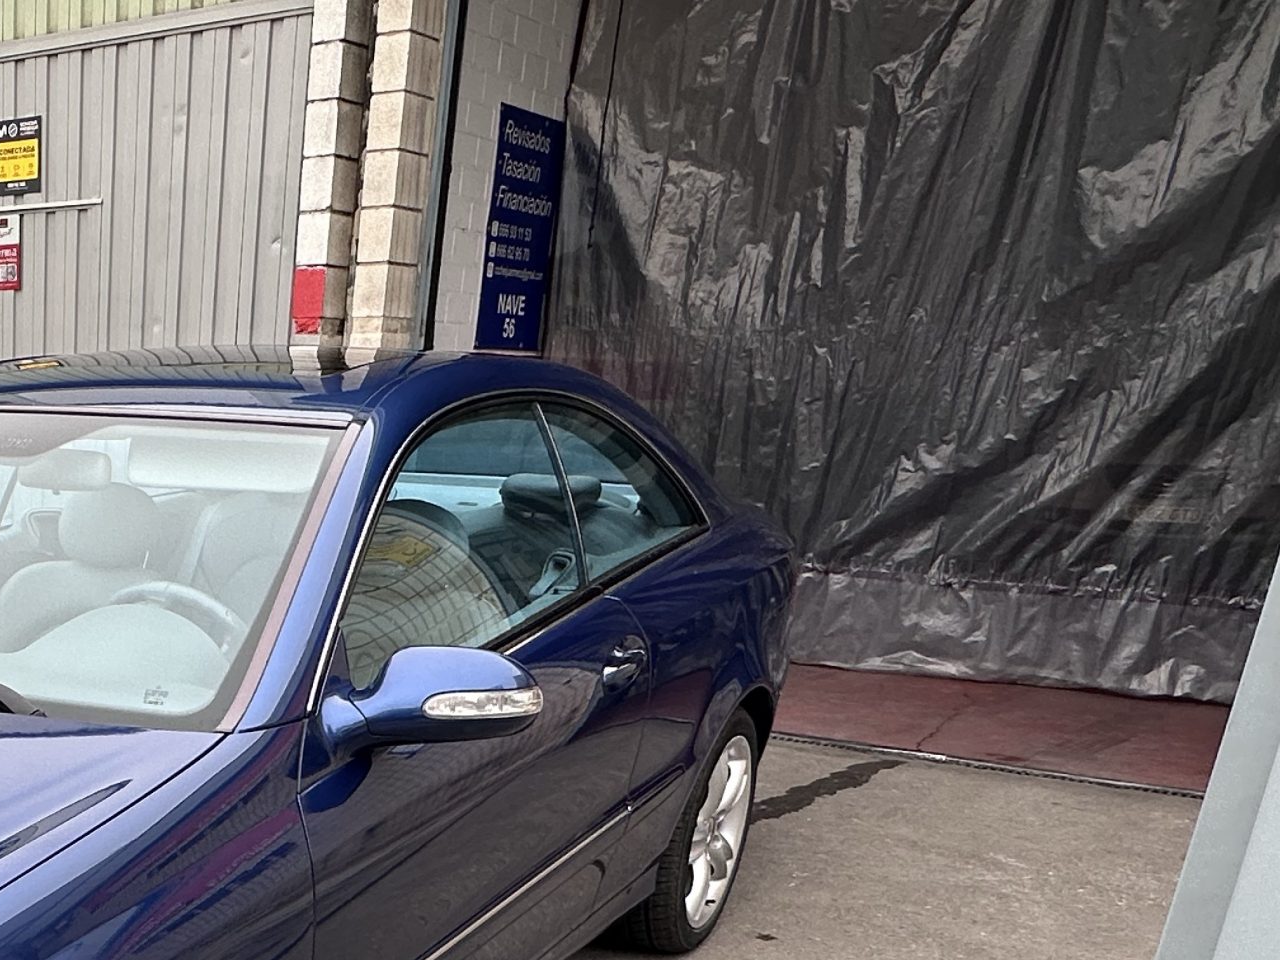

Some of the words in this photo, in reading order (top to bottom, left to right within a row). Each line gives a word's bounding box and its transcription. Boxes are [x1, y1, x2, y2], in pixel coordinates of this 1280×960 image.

[504, 120, 551, 154] Revisados
[502, 152, 541, 183] Tasación
[496, 185, 552, 217] Financiación
[497, 293, 526, 316] NAVE
[502, 318, 516, 338] 56
